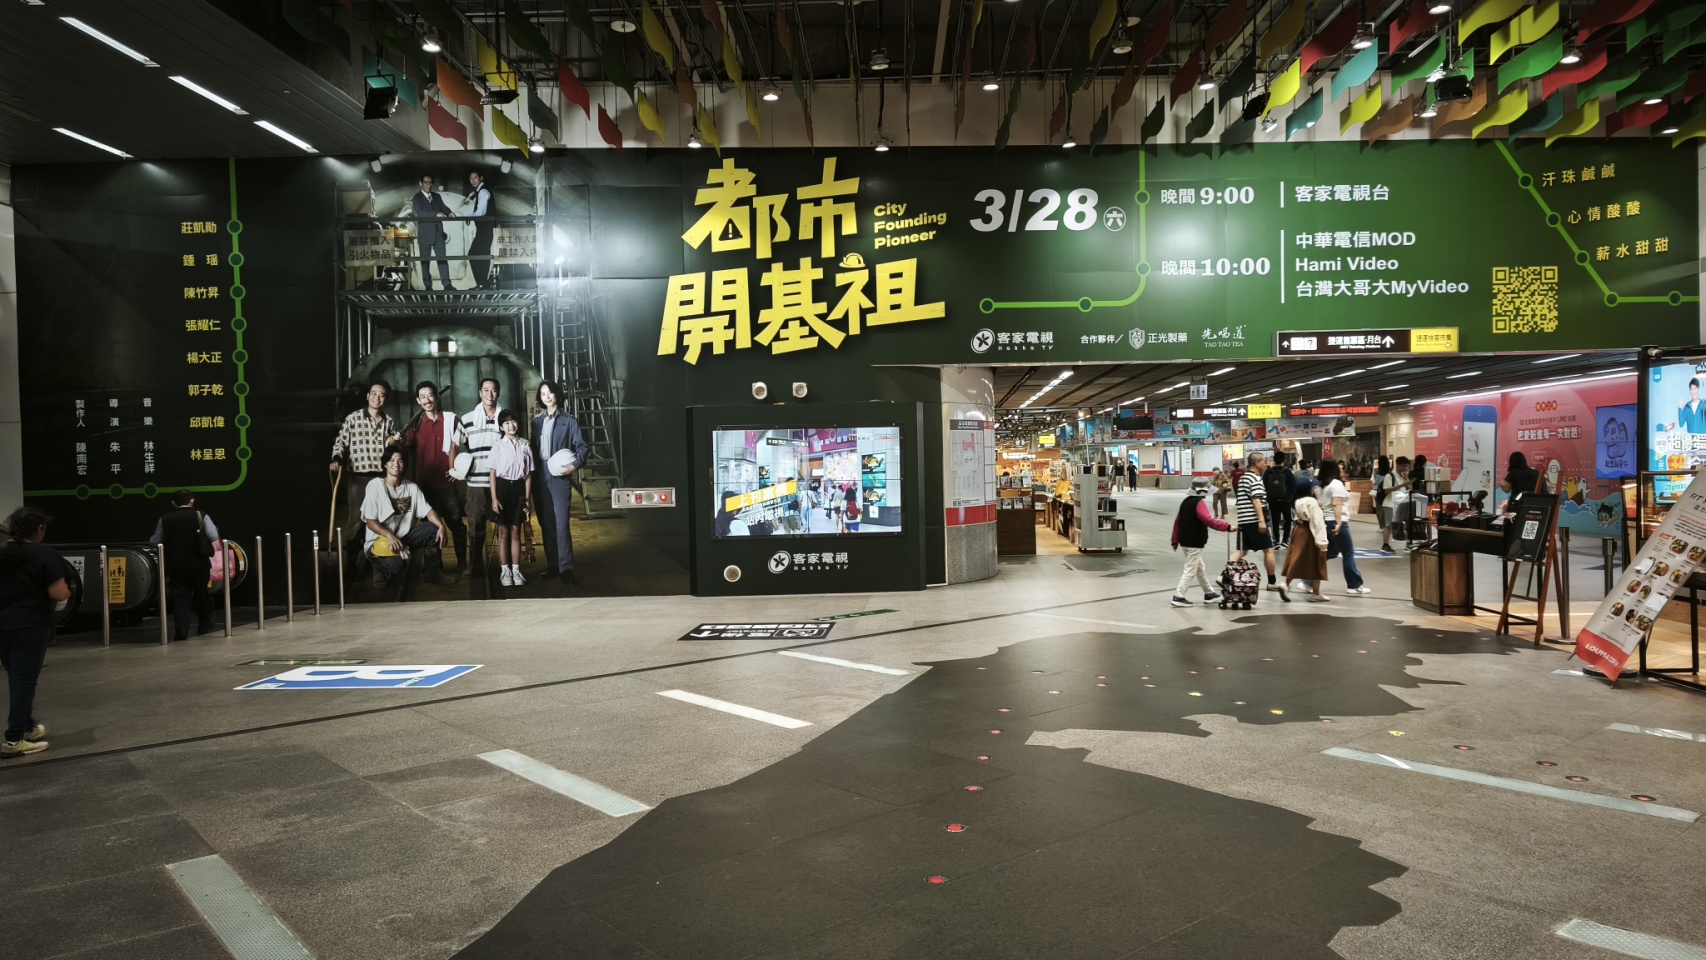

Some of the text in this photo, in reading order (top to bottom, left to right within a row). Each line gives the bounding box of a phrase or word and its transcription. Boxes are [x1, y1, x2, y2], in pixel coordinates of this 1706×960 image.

[1542, 163, 1616, 187] 汗珠鹹鹹
[1160, 186, 1255, 205] 晚間 9:00
[1295, 184, 1390, 202] 客家電視台
[681, 157, 860, 259] 都市
[874, 202, 907, 218] City
[969, 187, 1126, 233] 3/28 六
[1567, 200, 1641, 225] 心情酸酸
[874, 211, 947, 233] Founding
[874, 229, 937, 249] Pioneer
[1295, 231, 1416, 249] 中華電信MOD
[349, 249, 391, 261] 引火物品
[1596, 237, 1669, 261] 薪水甜甜
[1161, 257, 1271, 277] 晚間 10:00
[1295, 256, 1399, 272] Hami Video
[184, 286, 219, 299] 陳竹昇
[1295, 279, 1469, 298] 台灣大哥大MyVideo
[657, 257, 946, 365] 開基祖
[185, 319, 221, 332] 張耀仁
[997, 331, 1054, 344] 客家電視
[1147, 332, 1188, 344] 正光製藥
[186, 351, 223, 364] 楊大正
[188, 384, 224, 396] 郭子乾
[189, 416, 225, 429] 邱凱偉
[75, 399, 88, 475] 製作人 陳南宏
[143, 397, 155, 474] 音樂 林生祥
[110, 442, 121, 475] 朱平
[190, 448, 226, 461] 林呈恩
[793, 552, 849, 564] 客家電視
